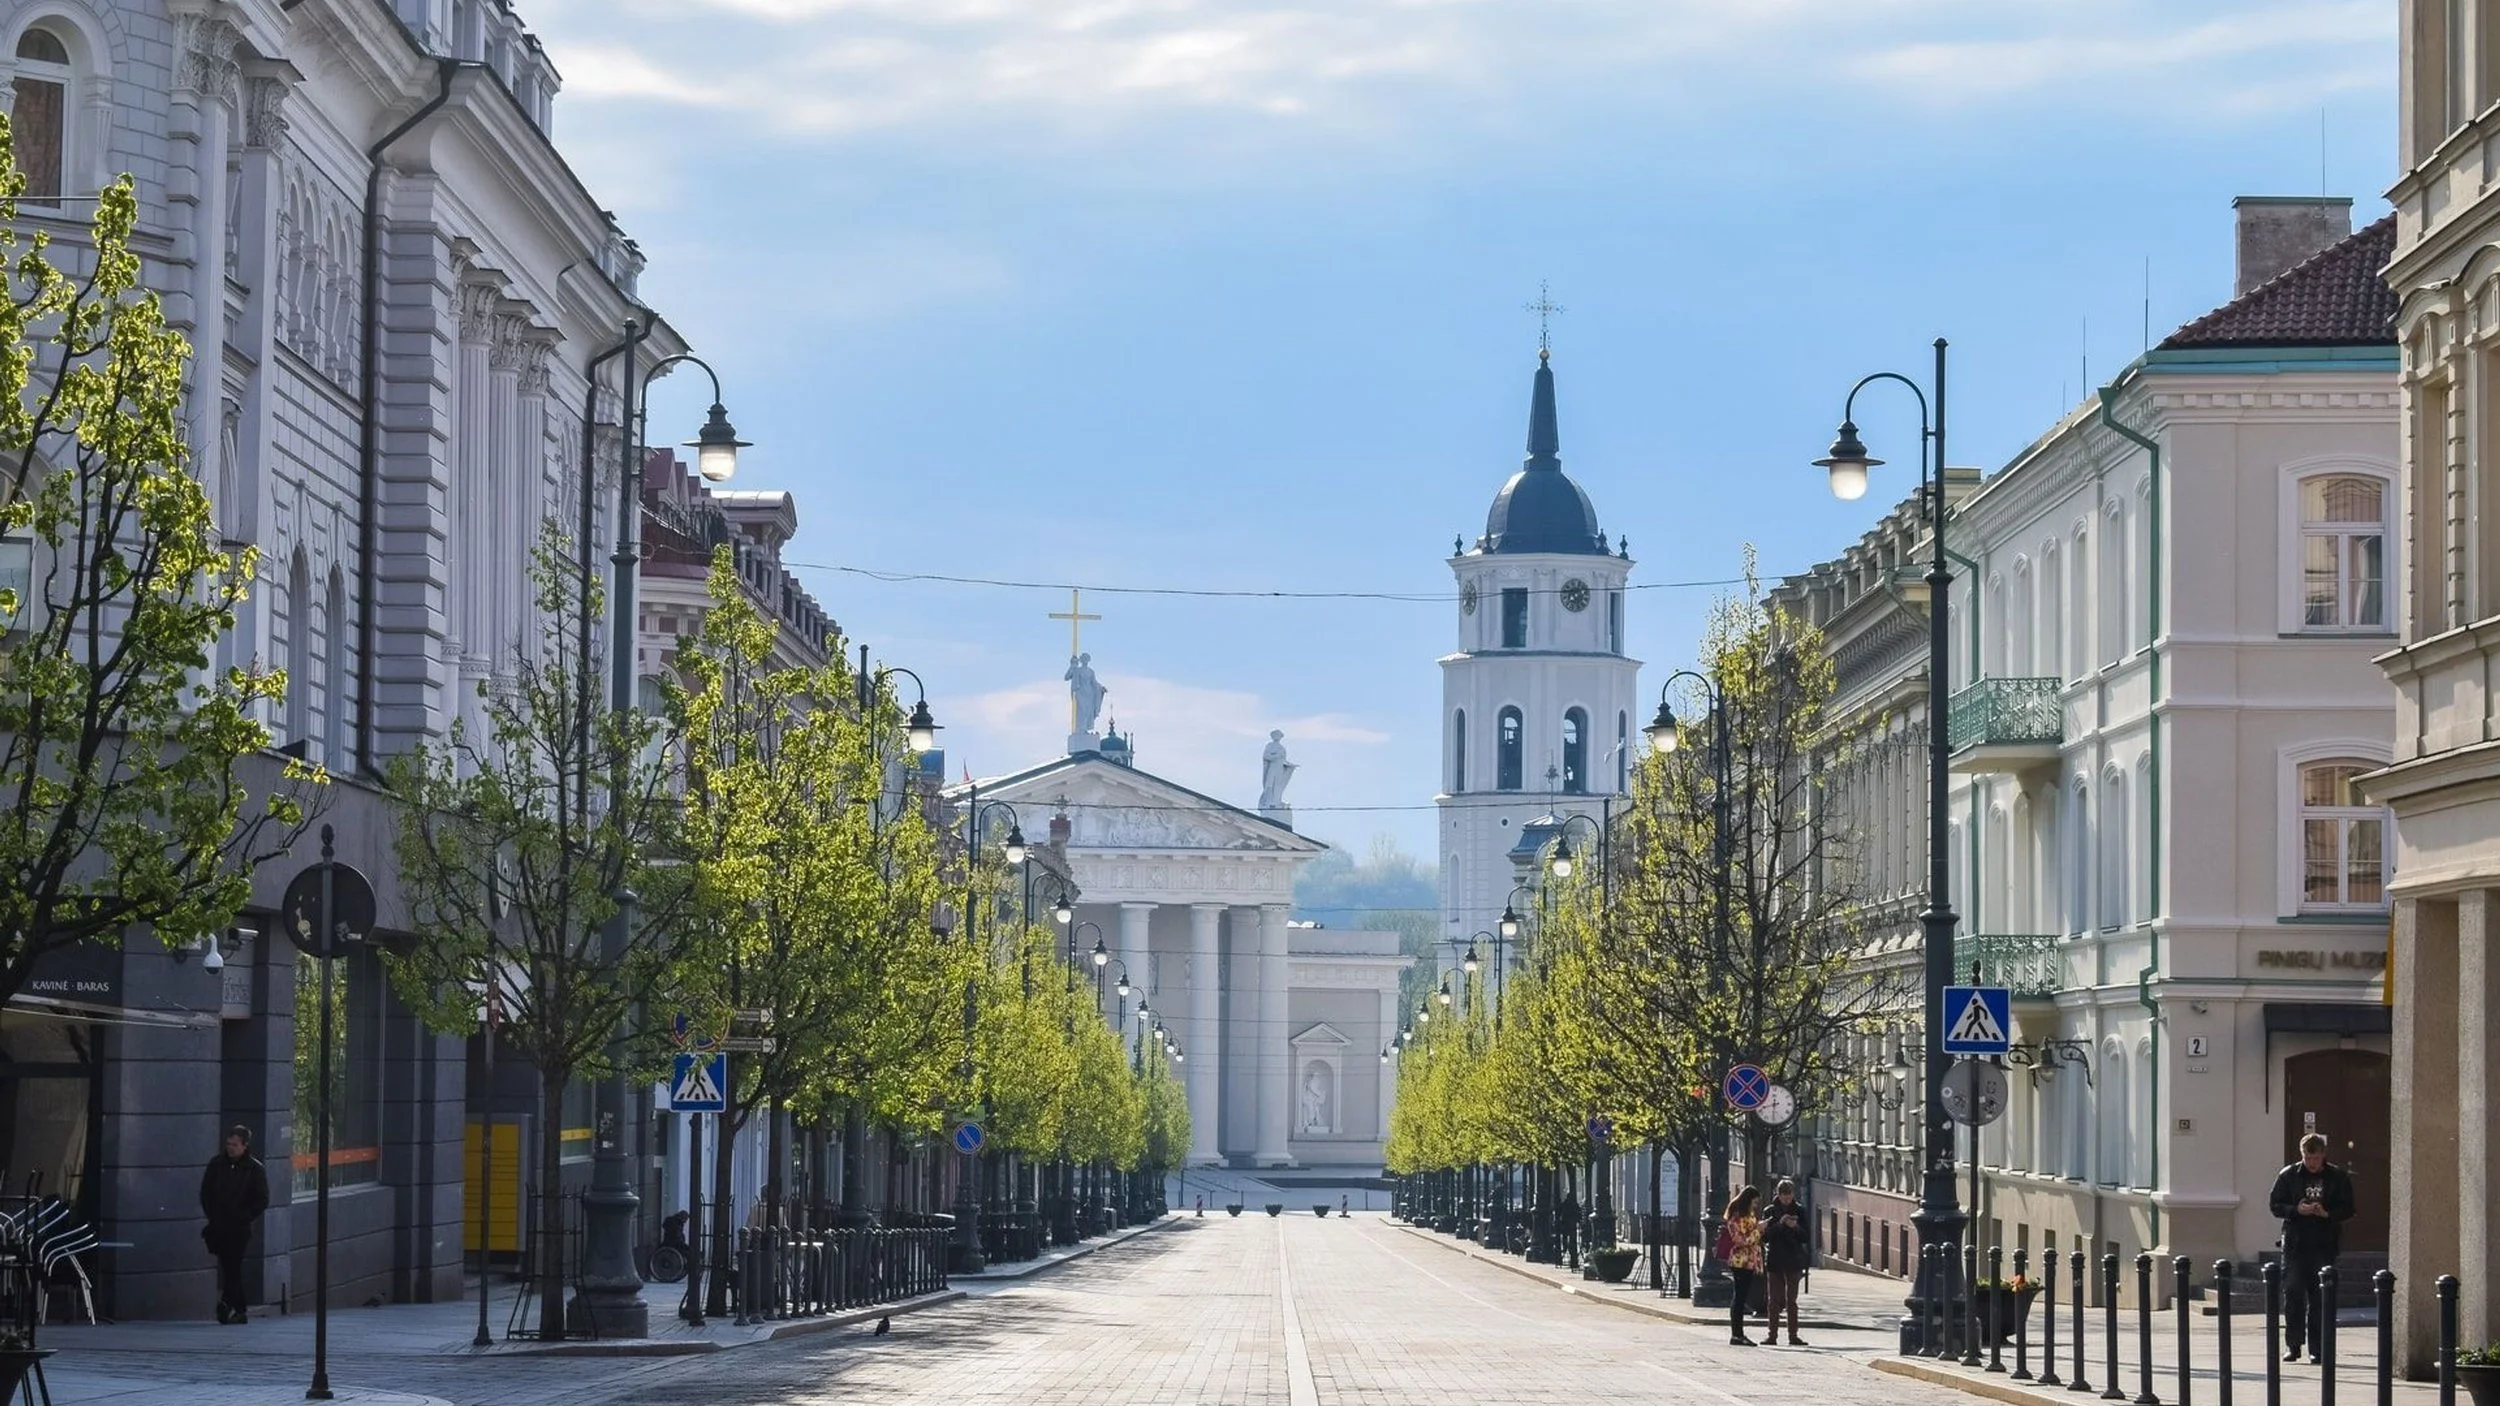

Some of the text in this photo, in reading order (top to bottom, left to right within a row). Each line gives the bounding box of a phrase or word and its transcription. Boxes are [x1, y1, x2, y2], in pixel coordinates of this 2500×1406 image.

[2258, 950, 2324, 971] PINIGŲ
[76, 981, 110, 992] BARAS
[2193, 1038, 2201, 1055] 2
